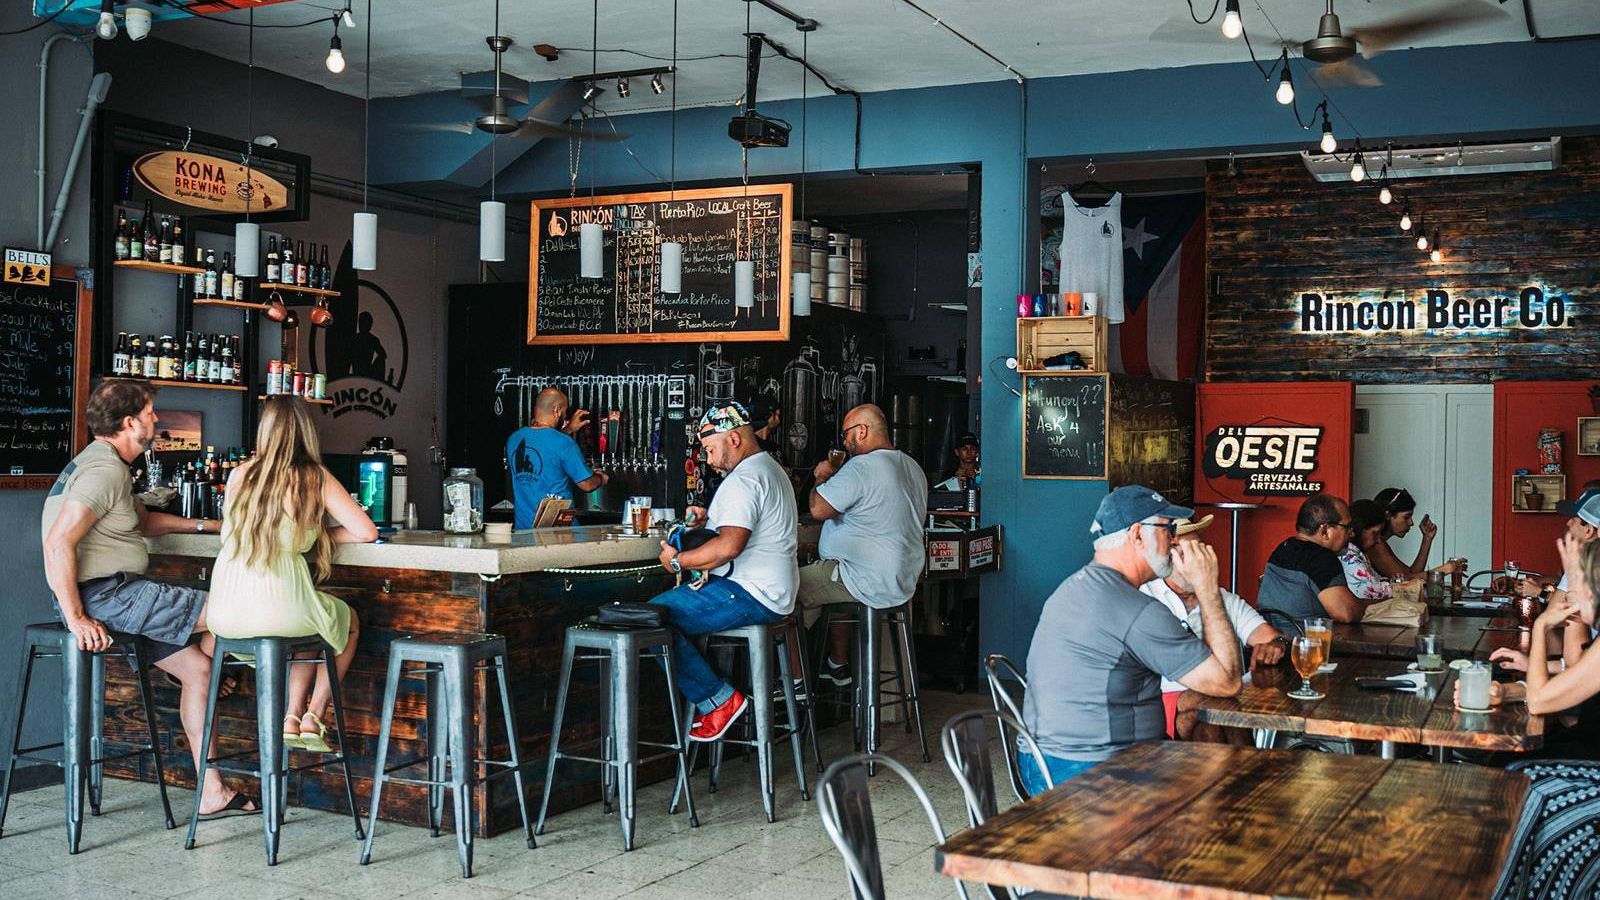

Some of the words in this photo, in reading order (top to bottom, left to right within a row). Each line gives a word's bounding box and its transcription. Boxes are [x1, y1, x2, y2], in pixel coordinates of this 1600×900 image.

[176, 157, 226, 184] KONA
[175, 177, 227, 196] BREWING
[571, 207, 613, 225] RINCÓN
[629, 204, 647, 219] TAX
[660, 203, 687, 219] Puerto
[687, 202, 705, 217] Rico
[708, 201, 733, 214] LOCAL
[754, 198, 772, 210] Beer
[8, 250, 49, 266] BELL'S
[1301, 290, 1415, 331] Rincón
[1427, 289, 1509, 330] Beer
[1519, 286, 1576, 328] Co.
[1070, 421, 1080, 434] 4
[1218, 427, 1243, 436] DEL
[1048, 434, 1066, 446] our
[1215, 427, 1320, 470] OESTE
[1250, 473, 1303, 483] CERVEZAS
[1249, 482, 1321, 492] ARTESANALES
